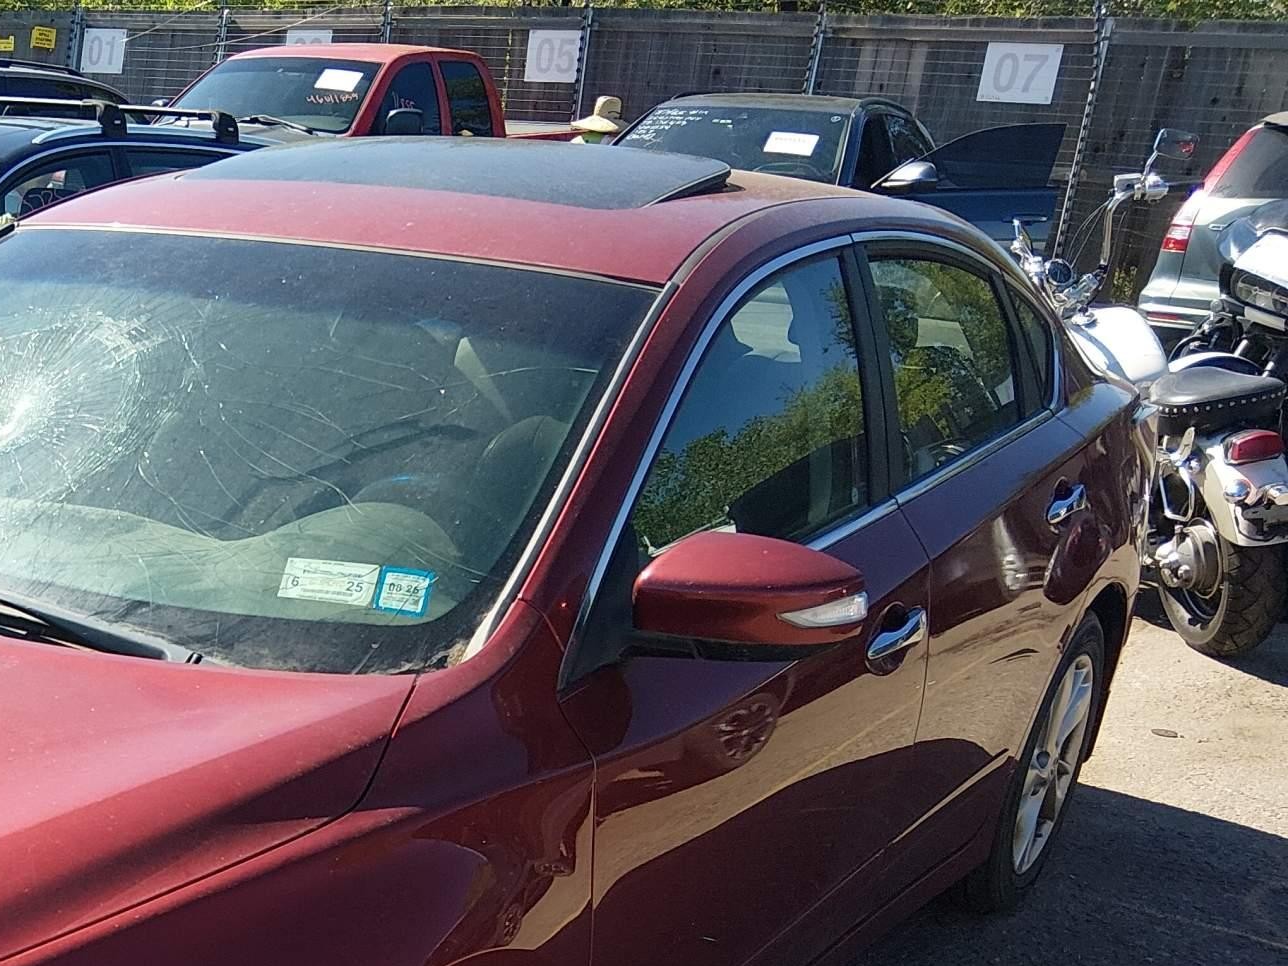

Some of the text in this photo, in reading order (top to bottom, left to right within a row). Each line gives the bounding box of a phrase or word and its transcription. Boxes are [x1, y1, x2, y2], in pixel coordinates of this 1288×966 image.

[88, 35, 116, 66] 01
[535, 38, 576, 74] 05
[993, 52, 1049, 93] 07
[291, 576, 300, 587] 6
[345, 581, 363, 593] 25
